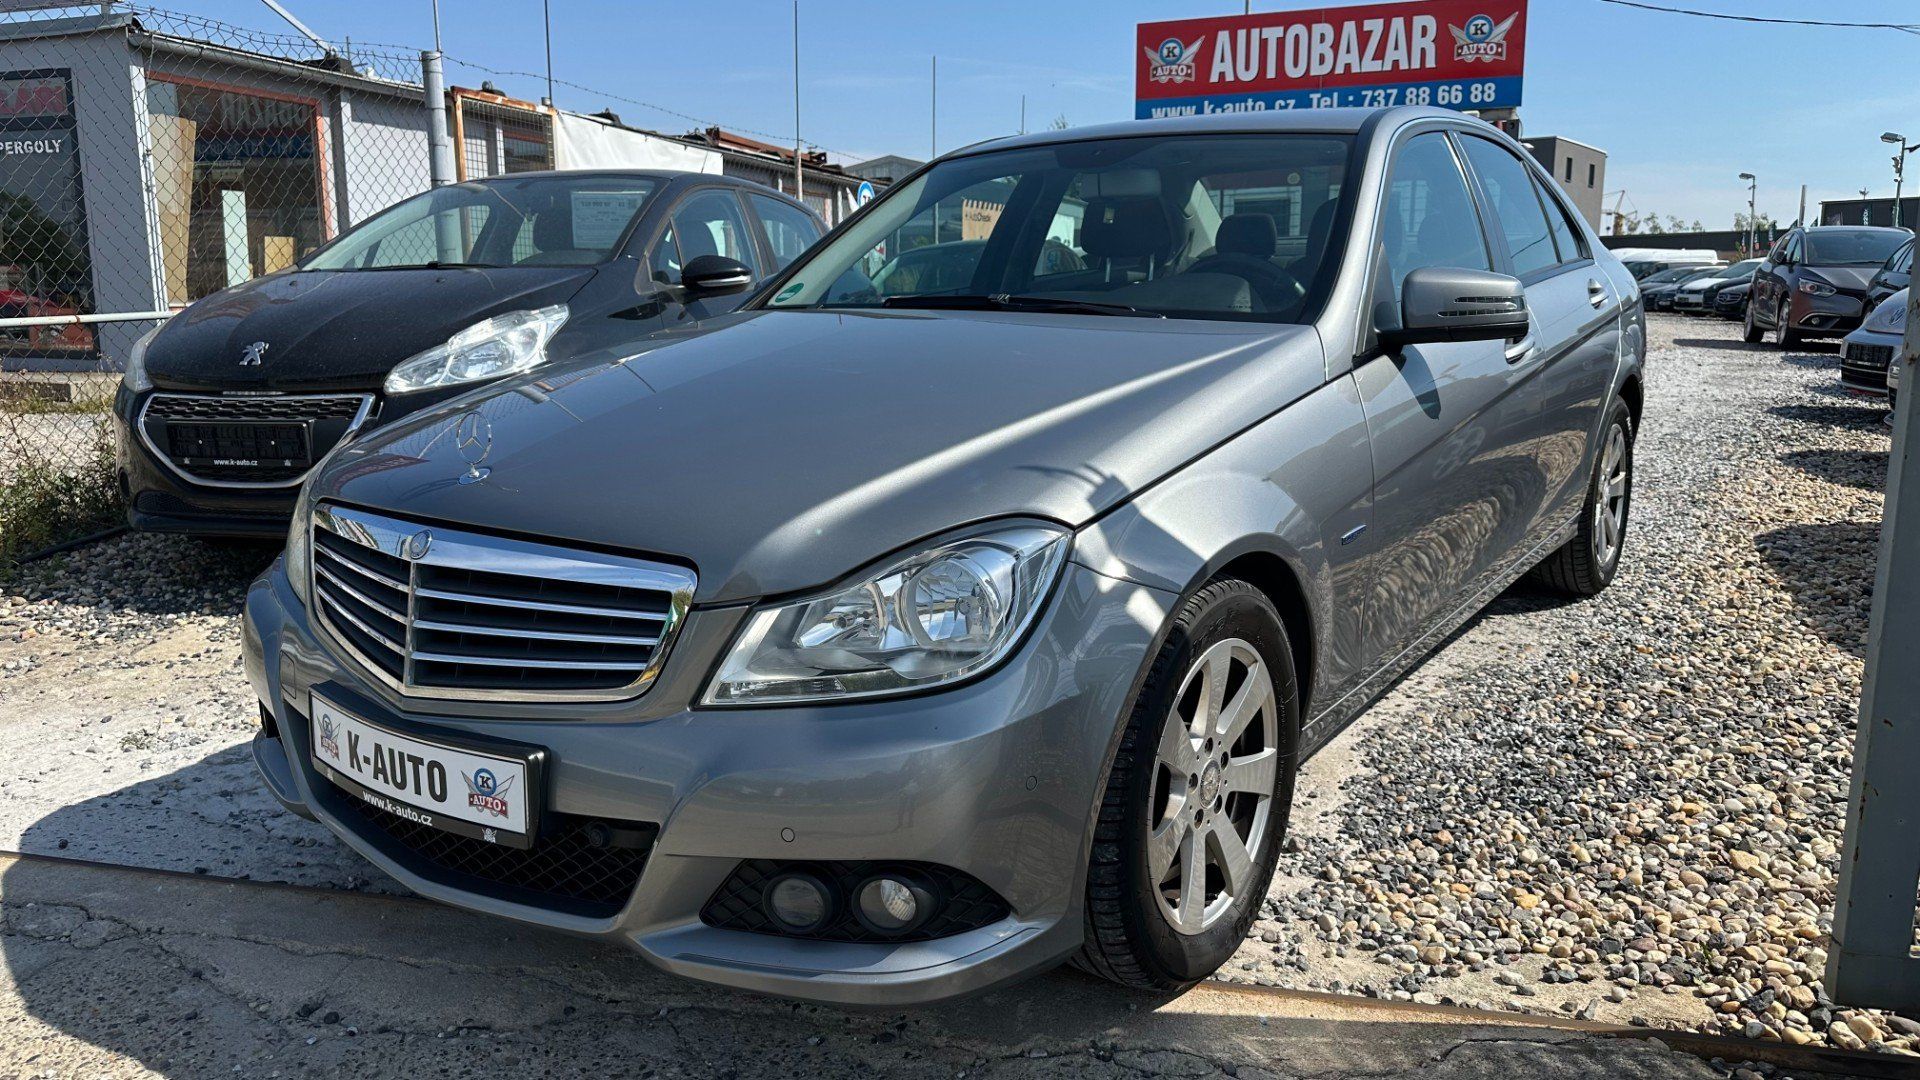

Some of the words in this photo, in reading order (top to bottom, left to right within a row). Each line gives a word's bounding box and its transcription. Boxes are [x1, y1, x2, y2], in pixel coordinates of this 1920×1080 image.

[1472, 23, 1486, 35] K
[1165, 46, 1177, 58] K
[1209, 14, 1437, 83] AUTOBAZAR
[1361, 88, 1398, 108] 737
[1405, 87, 1430, 106] 88
[1437, 84, 1463, 105] 66
[1470, 82, 1496, 103] 88
[347, 730, 448, 803] K-AUTO
[479, 775, 492, 790] K
[362, 790, 433, 826] www.k-auto.cz
